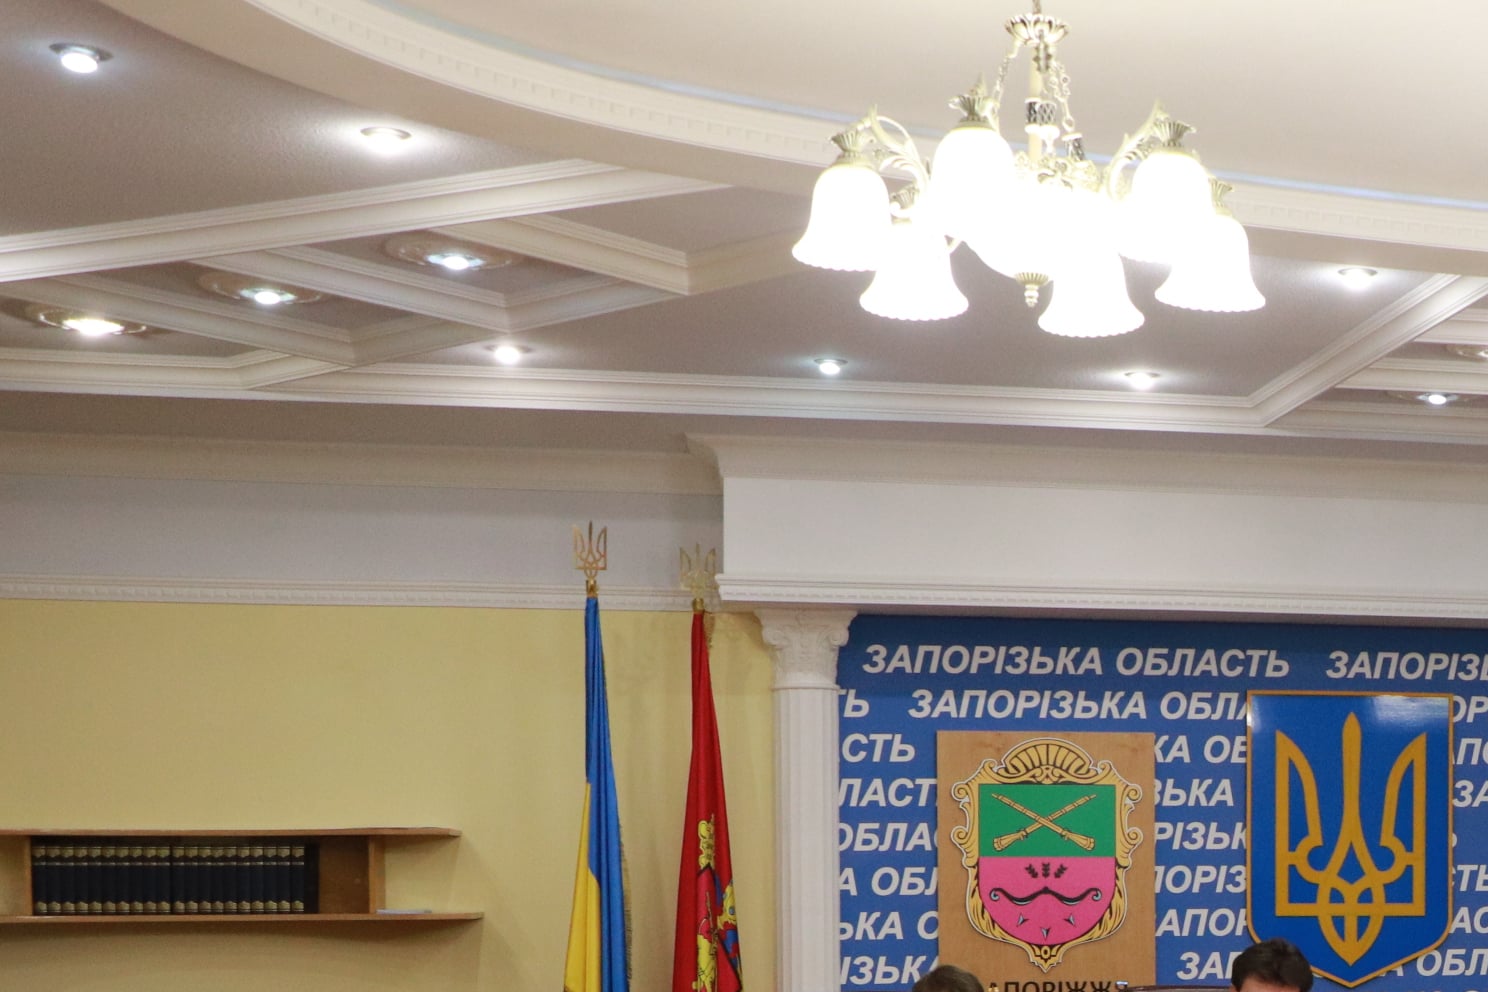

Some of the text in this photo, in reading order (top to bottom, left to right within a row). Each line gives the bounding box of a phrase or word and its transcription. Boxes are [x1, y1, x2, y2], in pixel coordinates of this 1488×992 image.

[862, 644, 1103, 675] ЗАПОРІЗЬКА
[1116, 647, 1290, 678] ОБЛАСТЬ
[908, 689, 1247, 721] ЗАПОРІЗЬКА ОБЛ
[839, 822, 938, 852] ОБЛА
